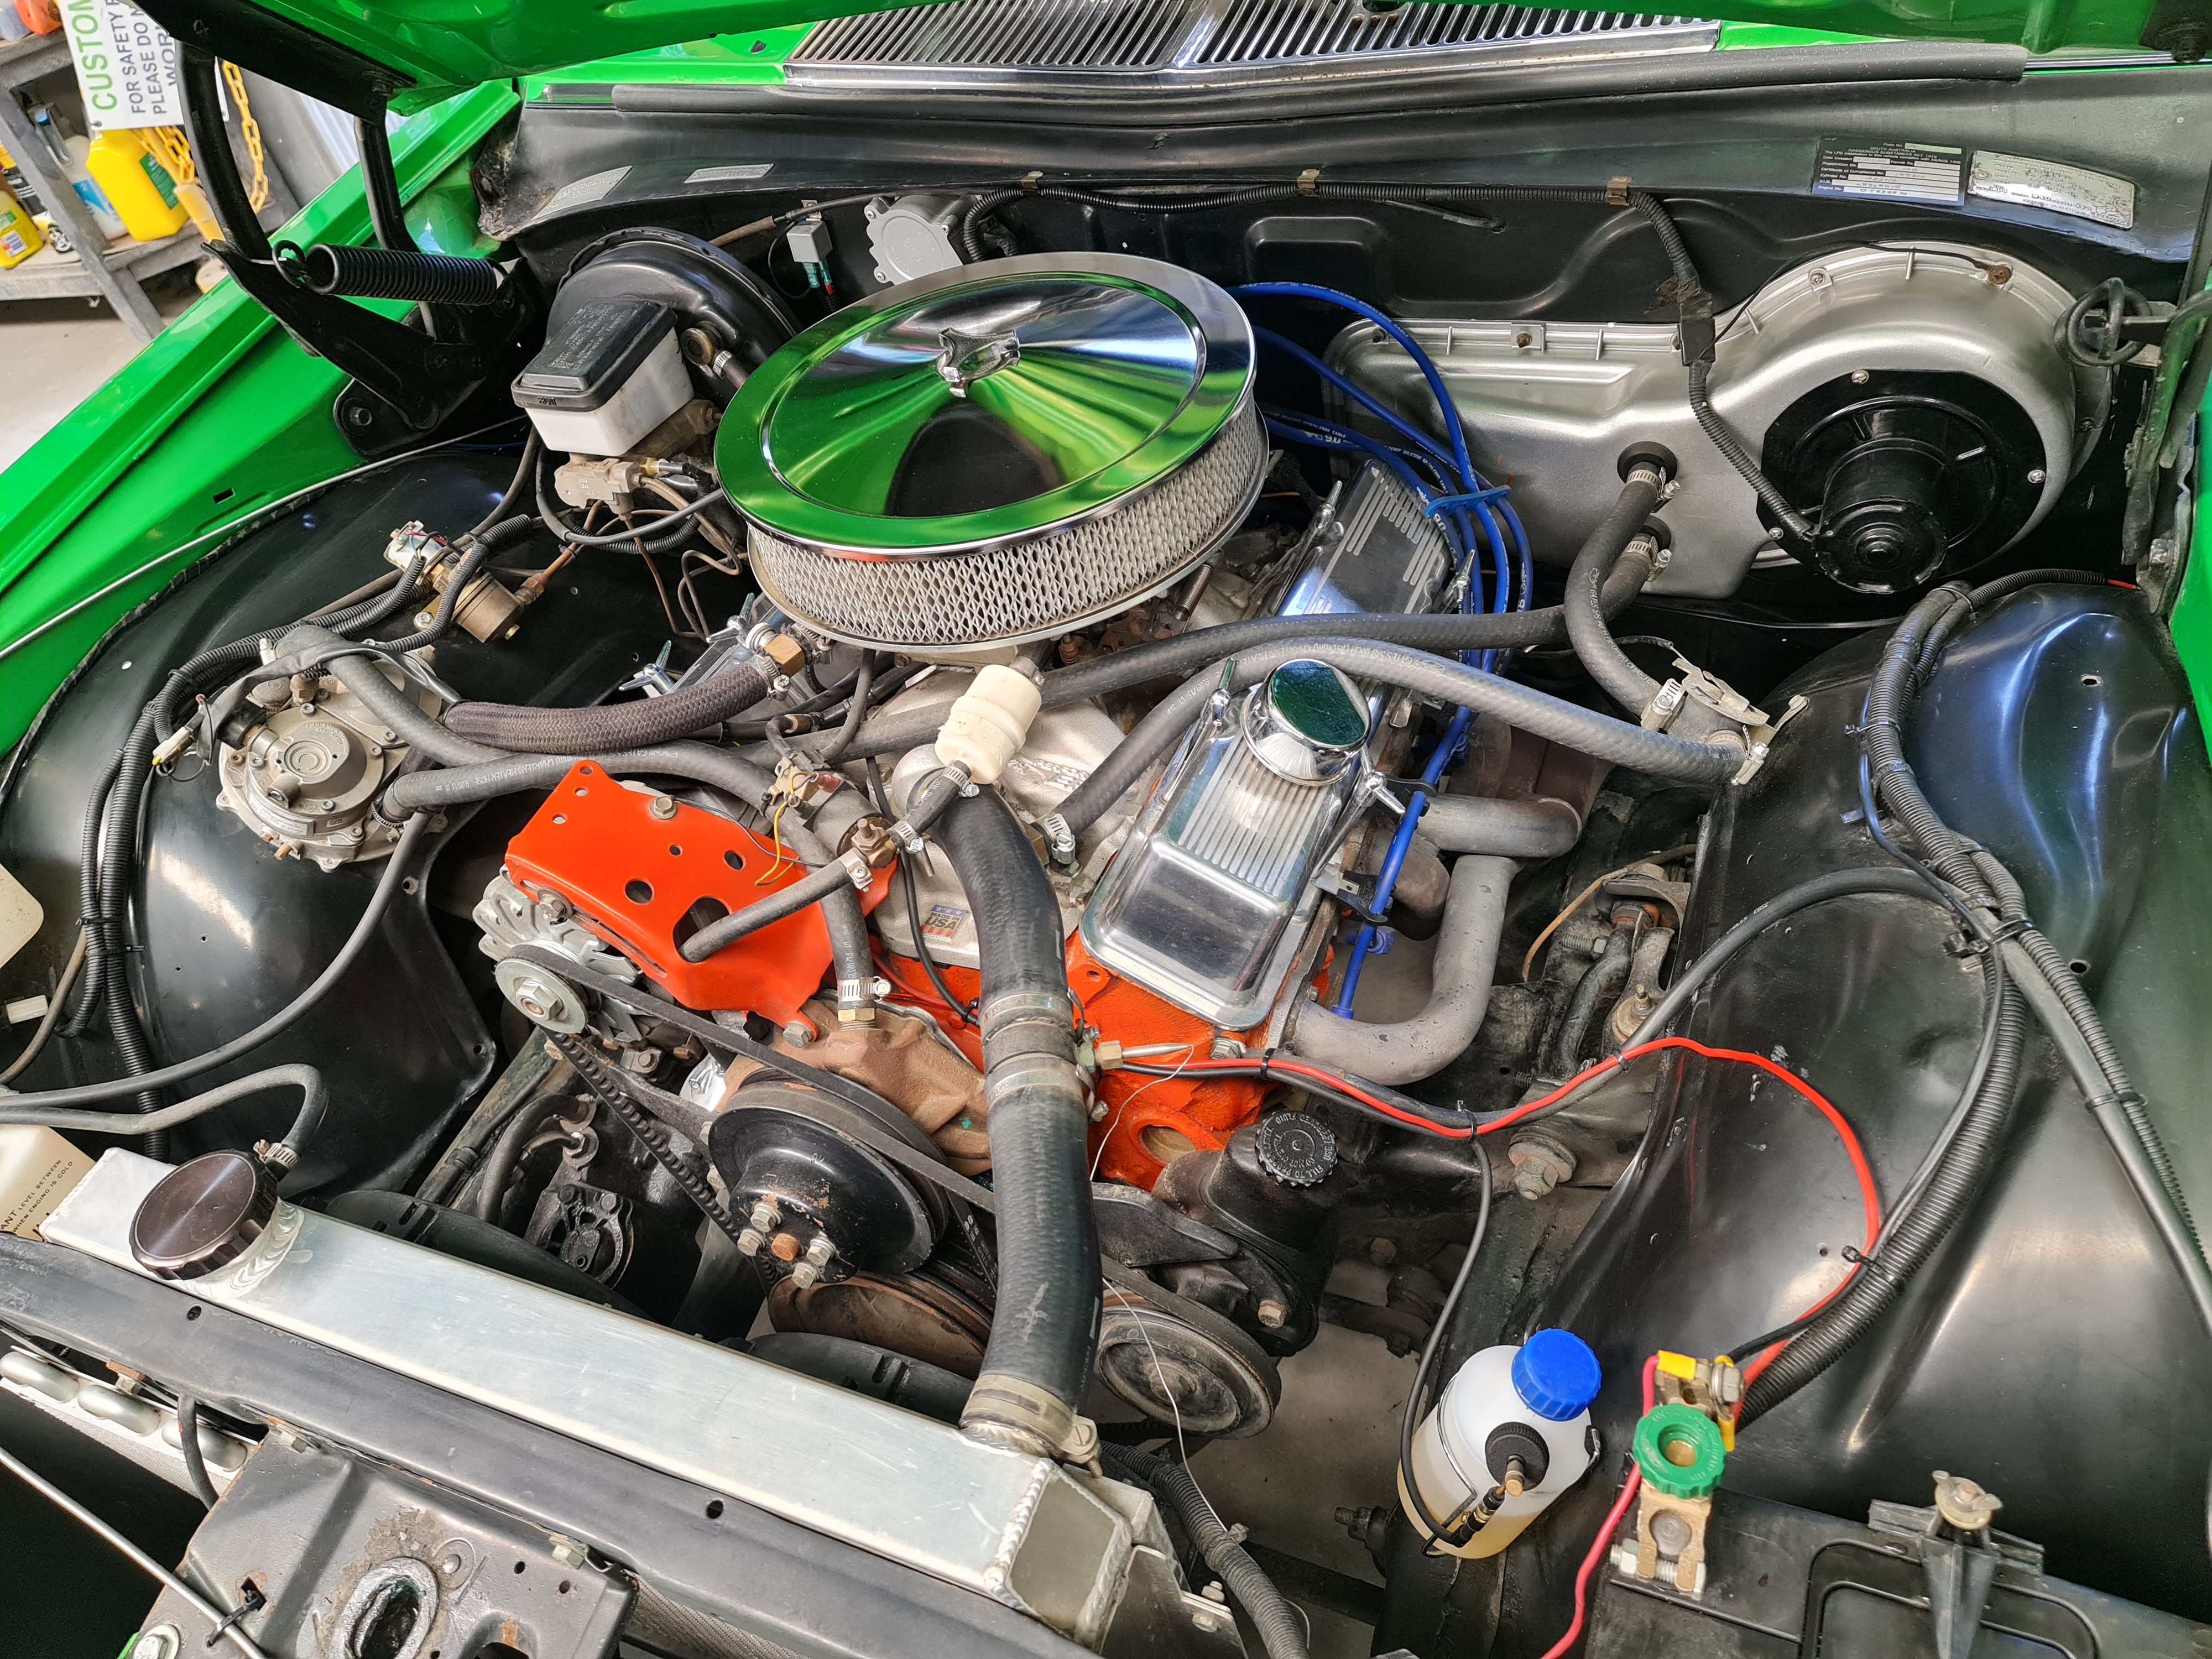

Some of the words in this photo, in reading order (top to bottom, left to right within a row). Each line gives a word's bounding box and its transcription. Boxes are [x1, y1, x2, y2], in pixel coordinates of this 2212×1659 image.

[133, 22, 151, 46] DO
[108, 12, 137, 75] SAFETY
[140, 51, 167, 114] PLEASE
[127, 81, 146, 114] FOR
[1432, 513, 1447, 531] 9.0
[474, 776, 491, 785] HOSE
[491, 769, 518, 782] HEATER
[925, 916, 959, 930] USA
[930, 912, 951, 920] MADE
[1275, 1113, 1297, 1124] FLUID
[1262, 1126, 1276, 1150] LEVEL
[1306, 1156, 1316, 1166] DO
[1323, 1147, 1333, 1161] USE
[1266, 1151, 1292, 1176] PROPER
[1290, 1159, 1306, 1168] NOT
[1306, 1165, 1325, 1178] FILL
[18, 1191, 36, 1211] LEVEL
[35, 1159, 62, 1190] BETWEEN
[12, 1213, 29, 1233] WHEN
[57, 1161, 73, 1179] COLD
[980, 1240, 989, 1255] GATES
